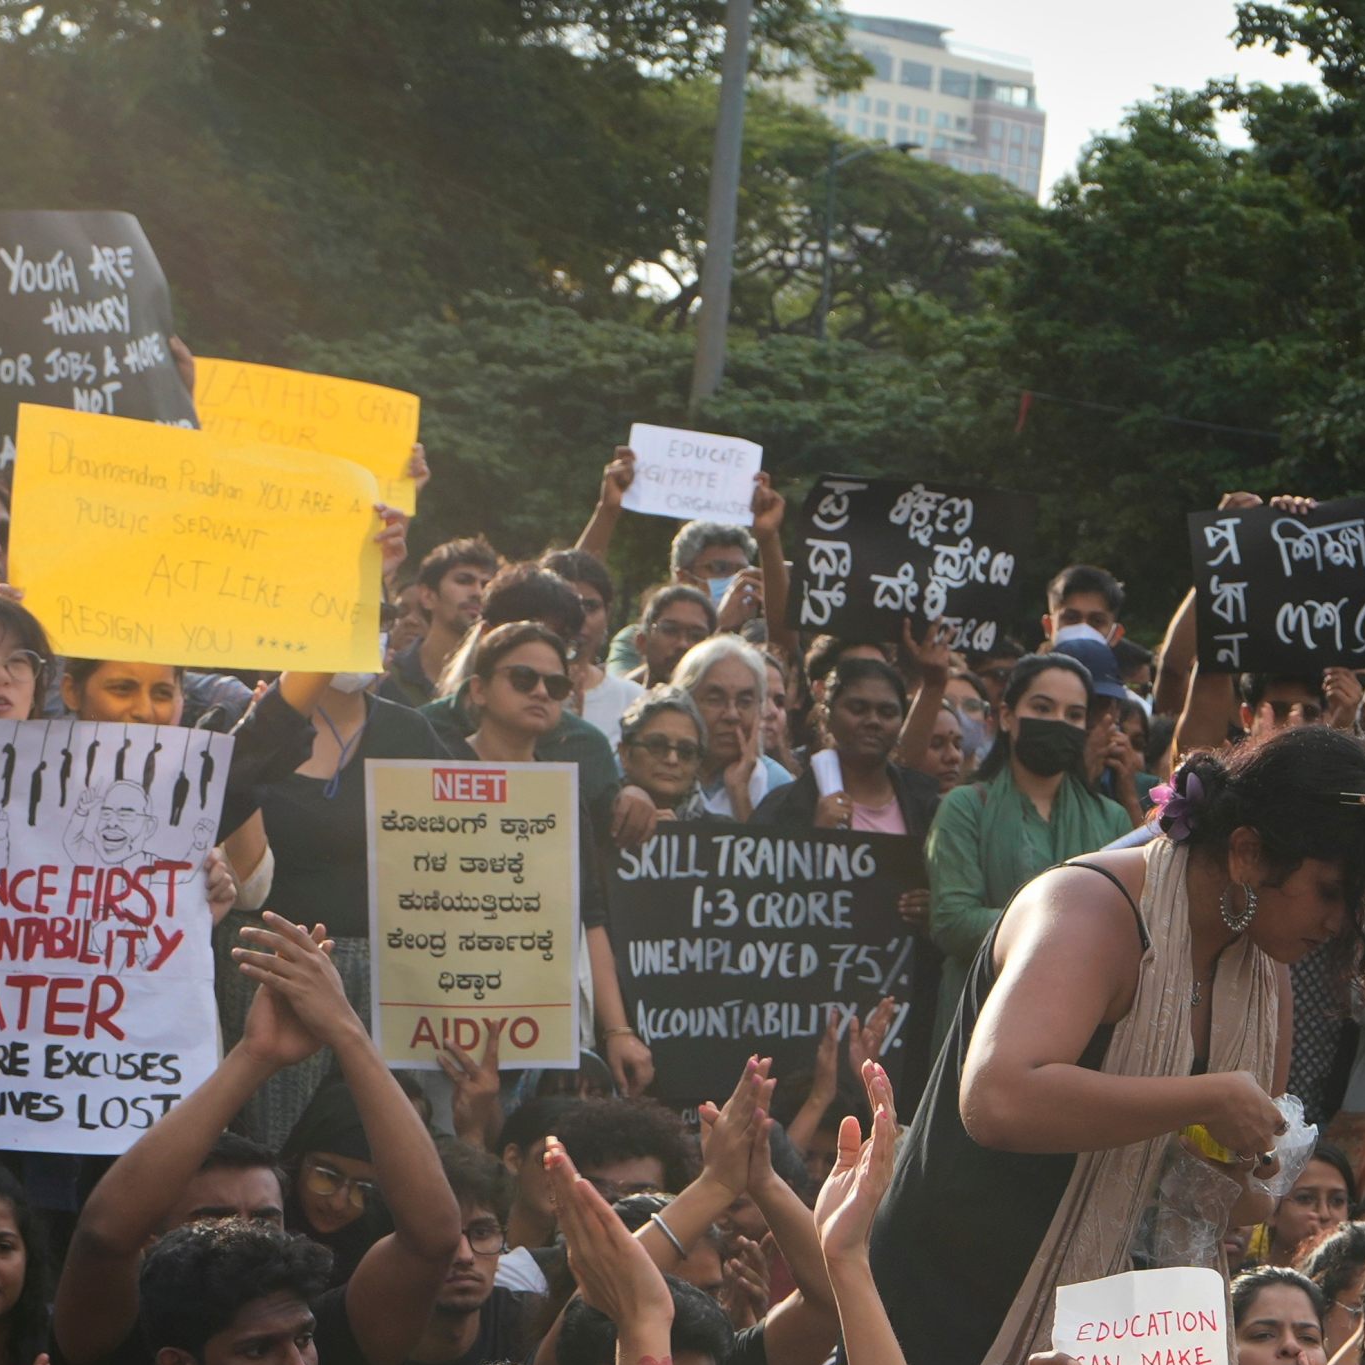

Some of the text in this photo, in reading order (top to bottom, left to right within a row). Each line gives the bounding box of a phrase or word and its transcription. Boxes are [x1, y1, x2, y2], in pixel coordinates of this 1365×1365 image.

[88, 245, 134, 289] ARE
[42, 294, 130, 335] HUNGRY
[44, 347, 96, 384] JOBS
[104, 345, 120, 377] &
[123, 331, 165, 374] HOPE
[73, 381, 122, 415] NOT
[256, 418, 322, 453] OUR
[667, 440, 749, 468] EDUCATE
[48, 431, 362, 514] Dharmendra Pradhan YOU ARE A
[76, 497, 269, 553] PUBLIC SERVANT
[144, 553, 366, 626] ACT LIKE ONE
[58, 594, 235, 655] RESIGN YOU
[434, 771, 507, 801] NEET
[381, 809, 557, 842] ಕೋಚಿಂಗ್ ಕ್ಲಾಸ್
[413, 851, 526, 883] ಗಳ ತಾಳಕ್ಕೆ
[616, 834, 876, 884] SKILL TRAINING
[66, 859, 193, 928] FIRST
[398, 891, 541, 920] ಕುಣಿಯುತ್ತಿರುವ
[747, 890, 853, 929] CRORE
[387, 927, 555, 961] ಕೇಂದ್ರ ಸರ್ಕಾರಕ್ಕೆ
[629, 935, 914, 995] UNEMPLOYED 75%
[438, 970, 503, 1000] ಧಿಕ್ಕಾರ
[410, 1015, 540, 1051] AIDYO
[637, 999, 858, 1045] ACCOUNTABILITY
[44, 1044, 182, 1085] EXCUSES
[77, 1093, 182, 1130] LOST
[1076, 1309, 1217, 1343] EDUCATION
